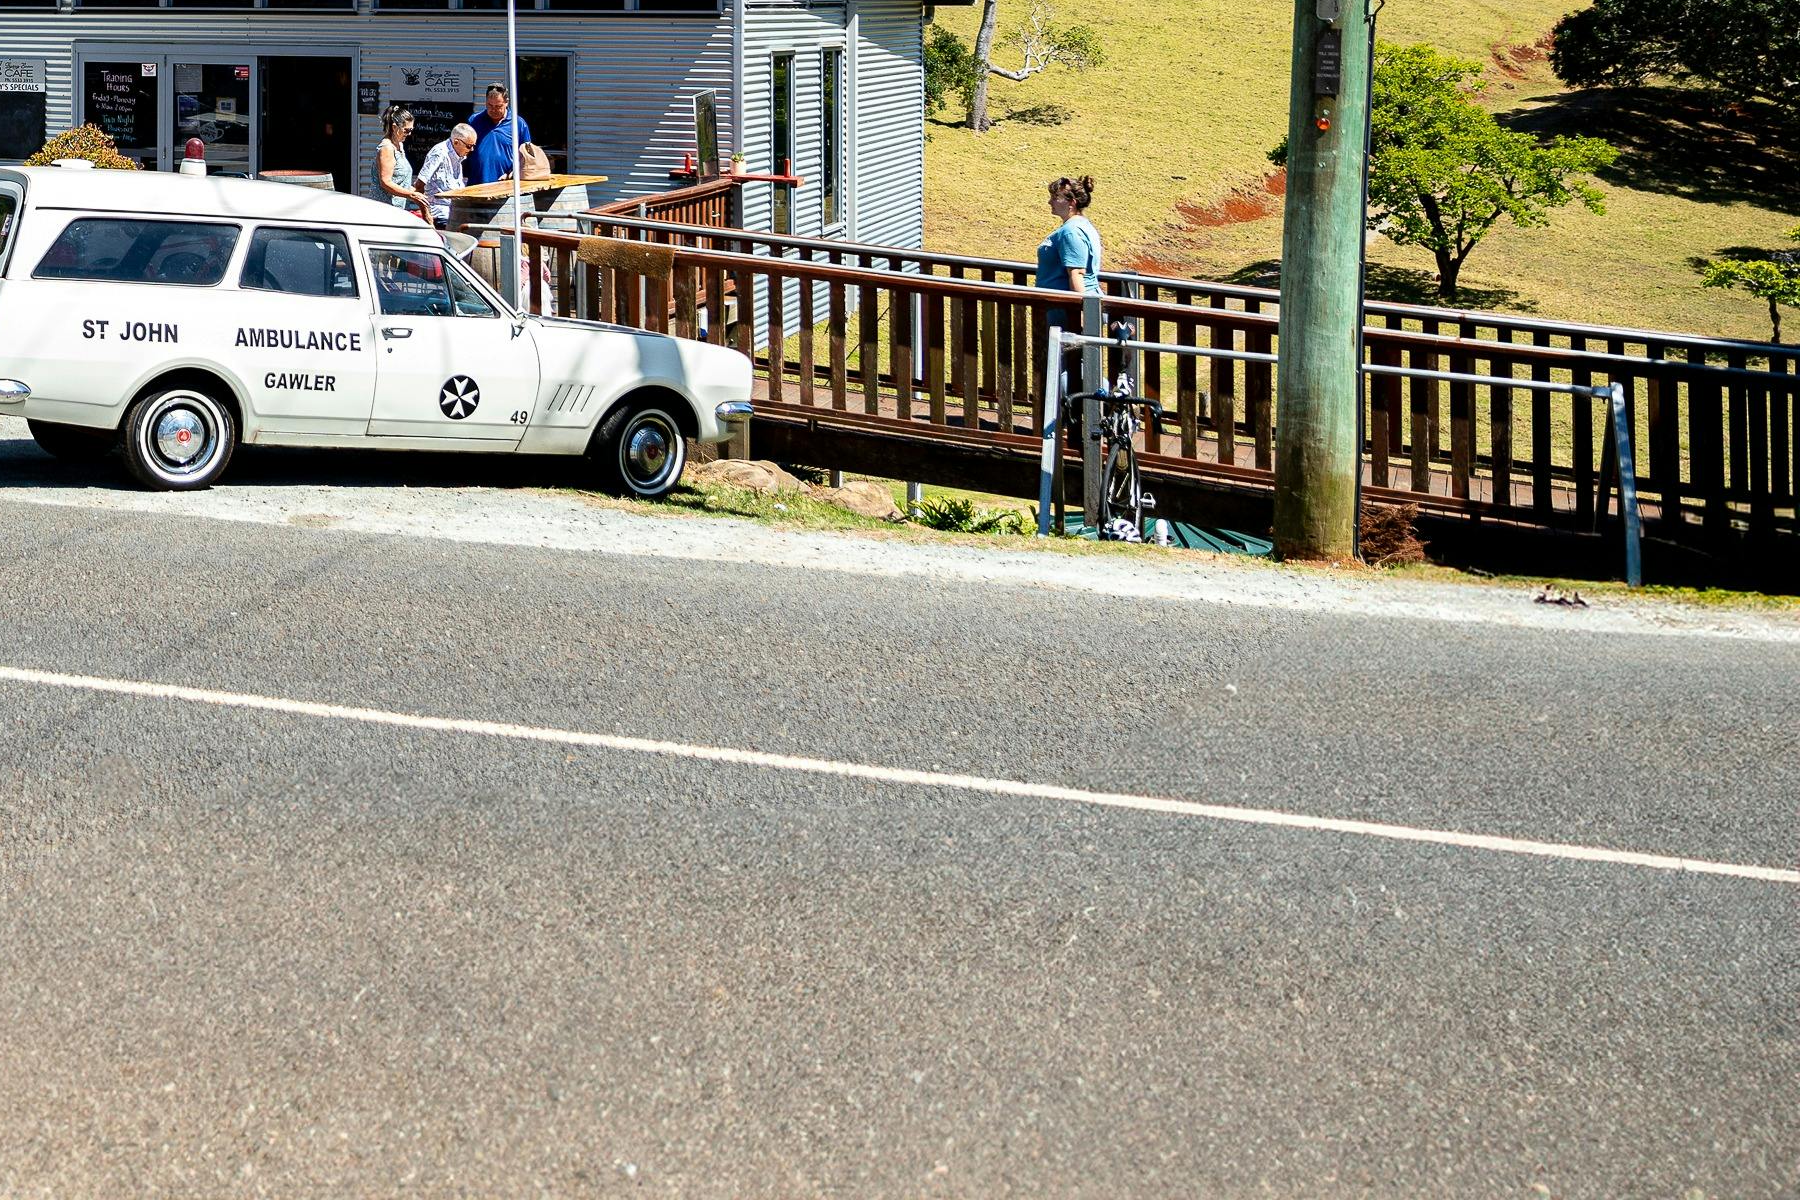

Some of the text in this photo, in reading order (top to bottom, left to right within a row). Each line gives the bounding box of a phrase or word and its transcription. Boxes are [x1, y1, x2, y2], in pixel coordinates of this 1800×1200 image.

[4, 69, 34, 78] CAFE
[424, 78, 460, 87] CAFE
[119, 321, 178, 343] JOHN
[234, 327, 362, 351] AMBULANCE
[264, 372, 336, 391] GAWLER
[510, 410, 528, 425] 49
